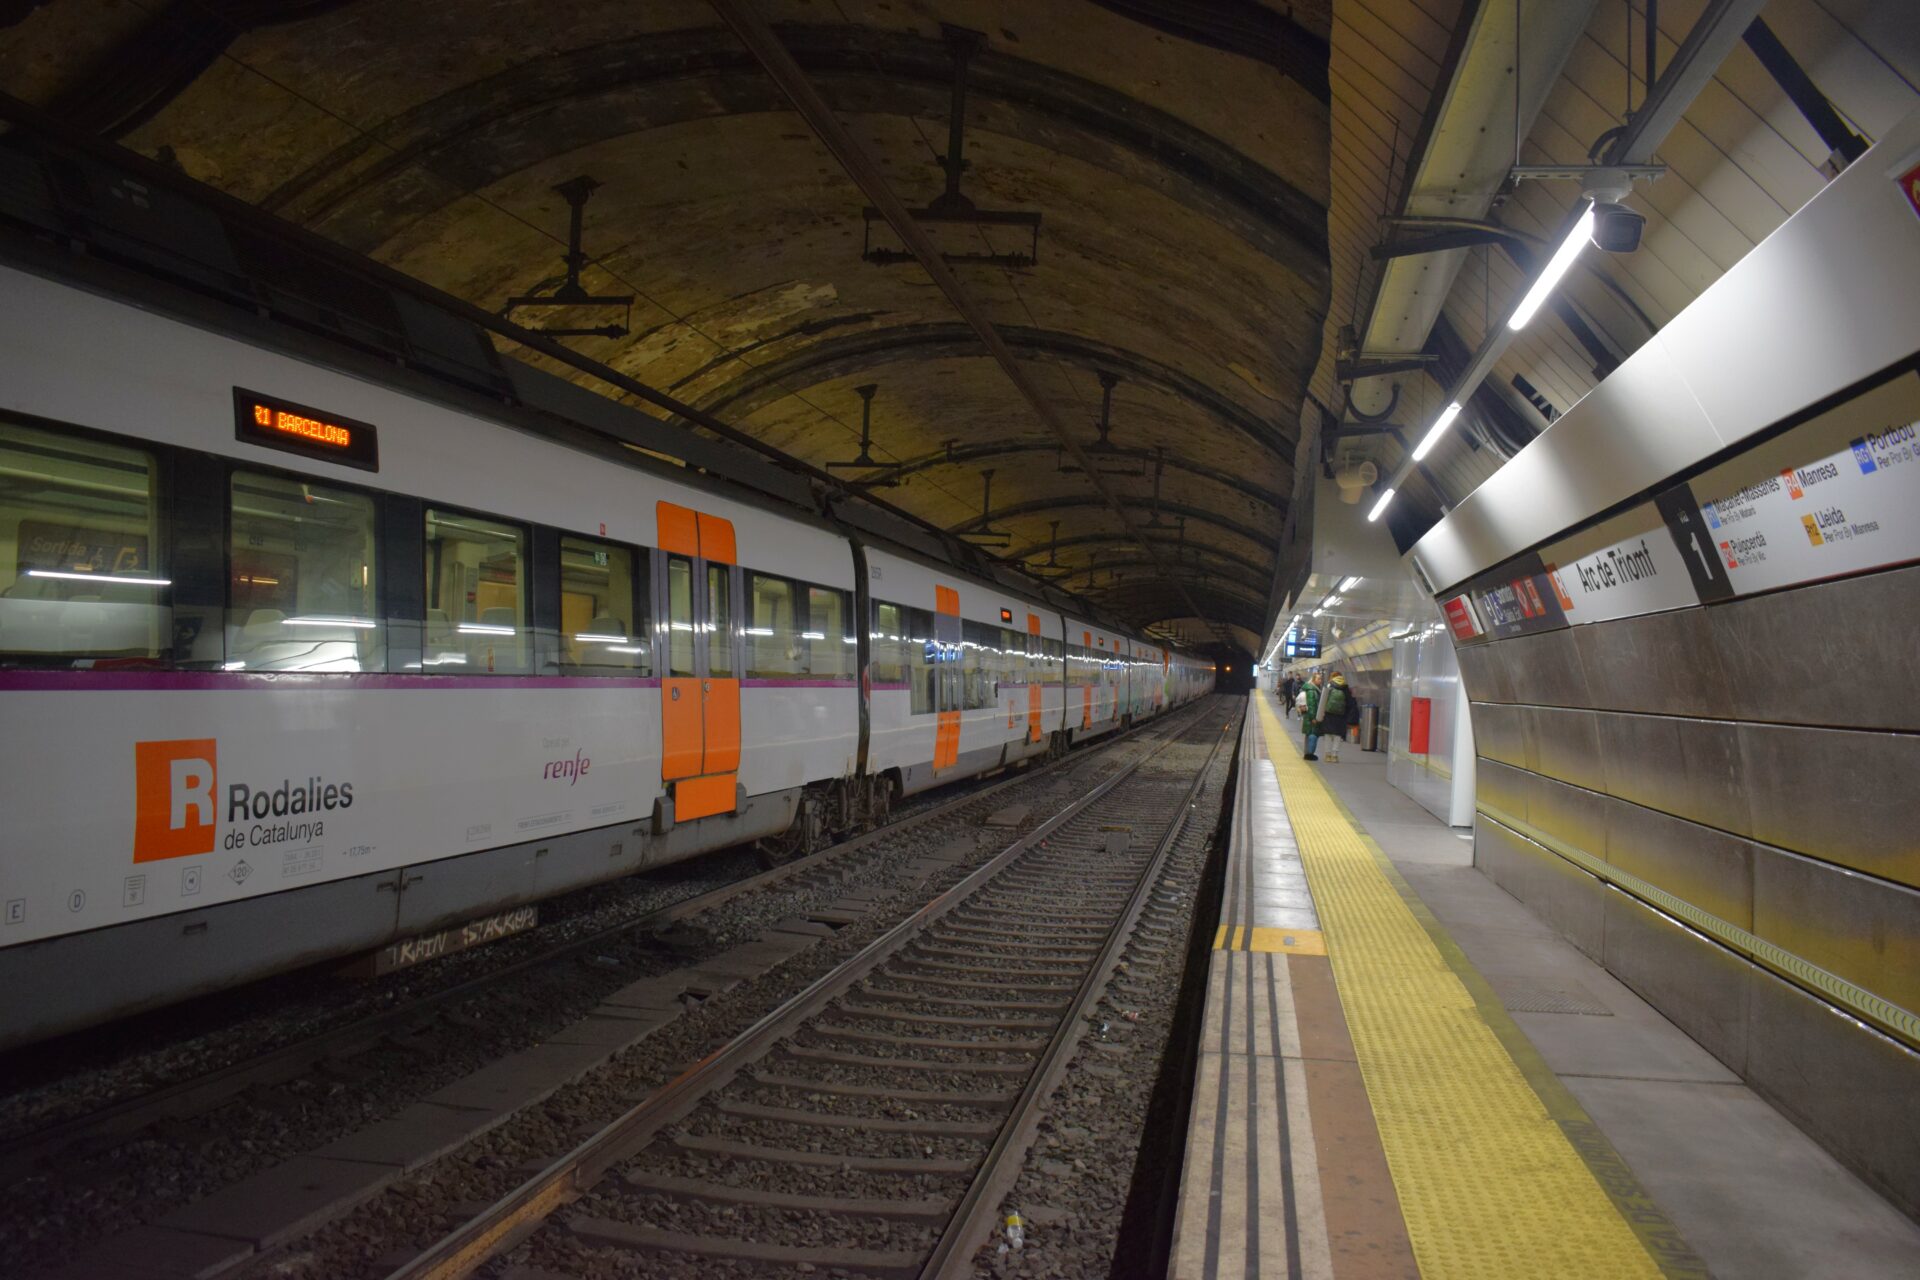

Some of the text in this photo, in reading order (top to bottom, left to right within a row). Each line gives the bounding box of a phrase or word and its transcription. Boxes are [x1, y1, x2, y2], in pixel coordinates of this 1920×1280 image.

[278, 411, 350, 446] BARCELONA
[1867, 422, 1915, 453] Portbou
[1785, 474, 1801, 491] R4
[1797, 463, 1838, 488] Manresa
[1805, 522, 1821, 538] R12
[1814, 507, 1846, 530] Lleida
[1851, 519, 1880, 536] Manresa
[31, 536, 87, 557] Sortida
[1690, 531, 1714, 581] 1
[1730, 530, 1768, 556] Puigcerdà
[1576, 562, 1601, 593] Arc
[1596, 555, 1616, 588] de
[1607, 539, 1657, 584] Triomf
[1551, 570, 1570, 601] R
[543, 747, 591, 787] renfe
[169, 757, 214, 830] R
[228, 776, 354, 823] Rodalies
[224, 820, 325, 851] de Catalunya
[233, 865, 248, 879] 120
[12, 904, 21, 919] E
